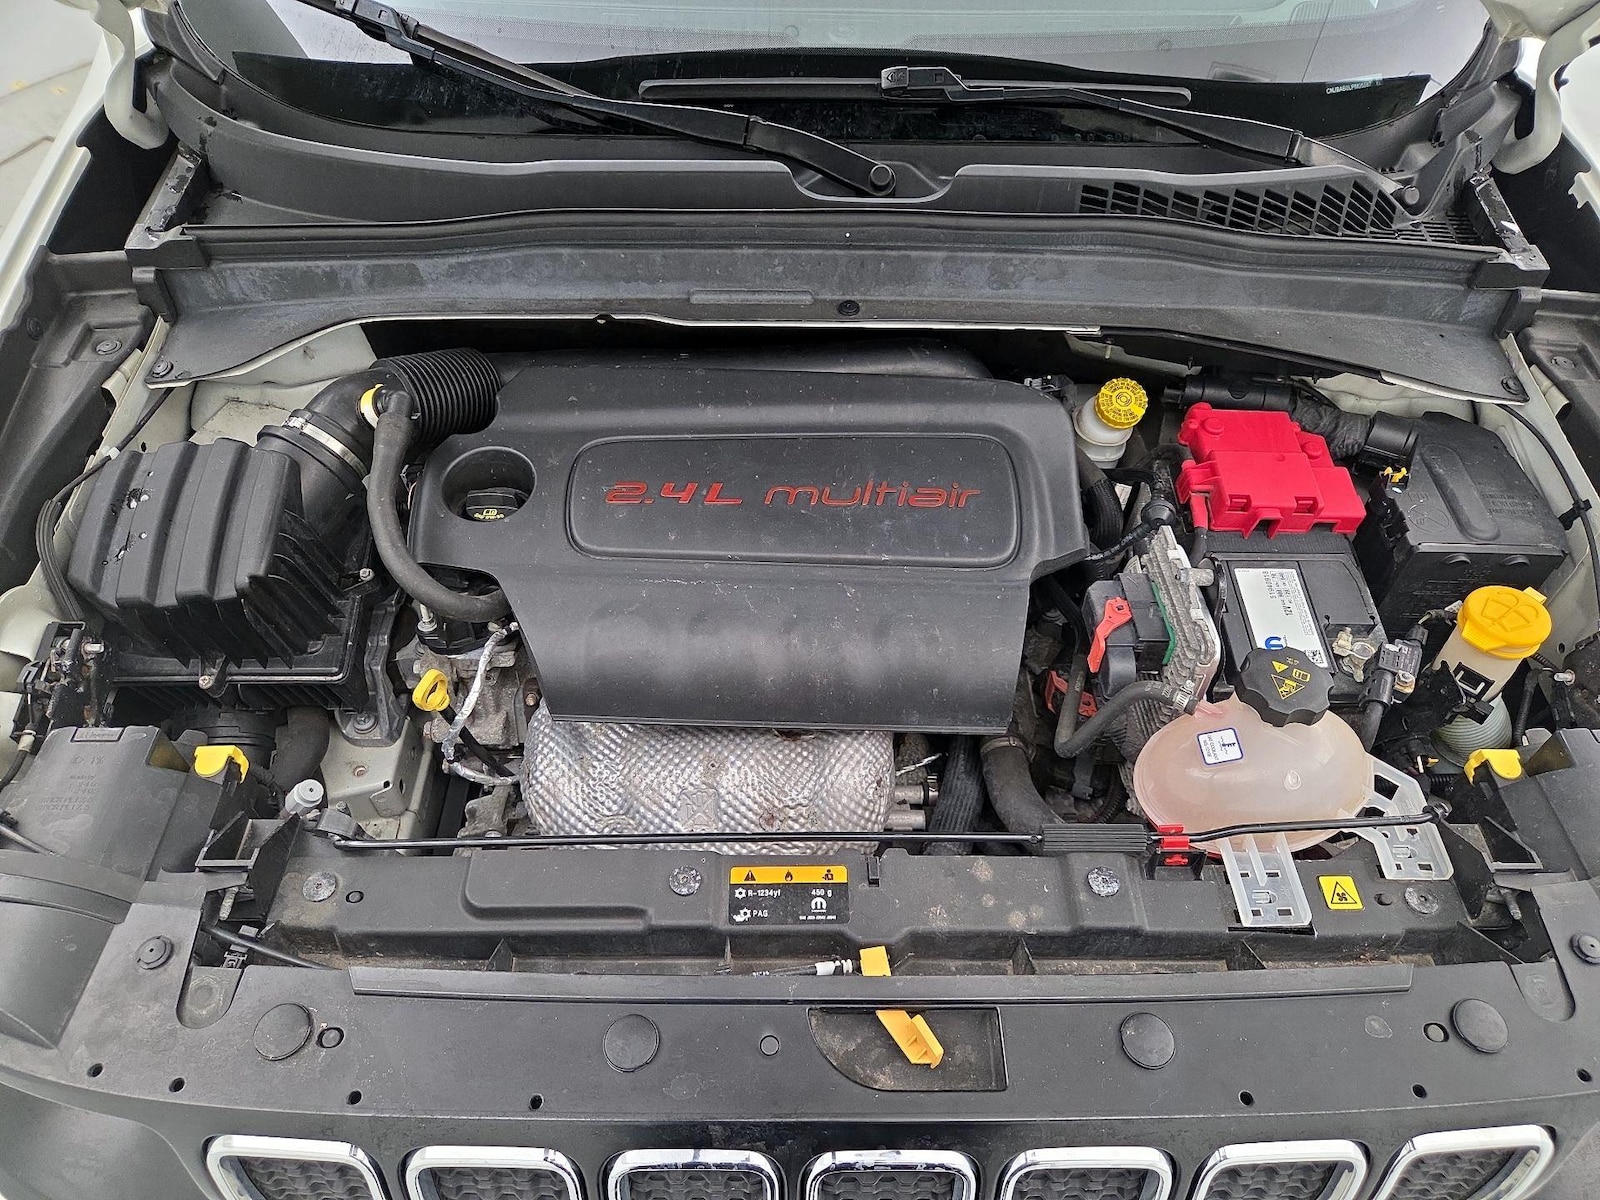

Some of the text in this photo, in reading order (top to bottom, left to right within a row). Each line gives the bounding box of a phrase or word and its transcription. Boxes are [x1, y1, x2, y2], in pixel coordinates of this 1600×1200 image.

[604, 478, 982, 508] 2.4L multiair
[748, 889, 780, 898] R-1234yf
[753, 909, 768, 918] PAG
